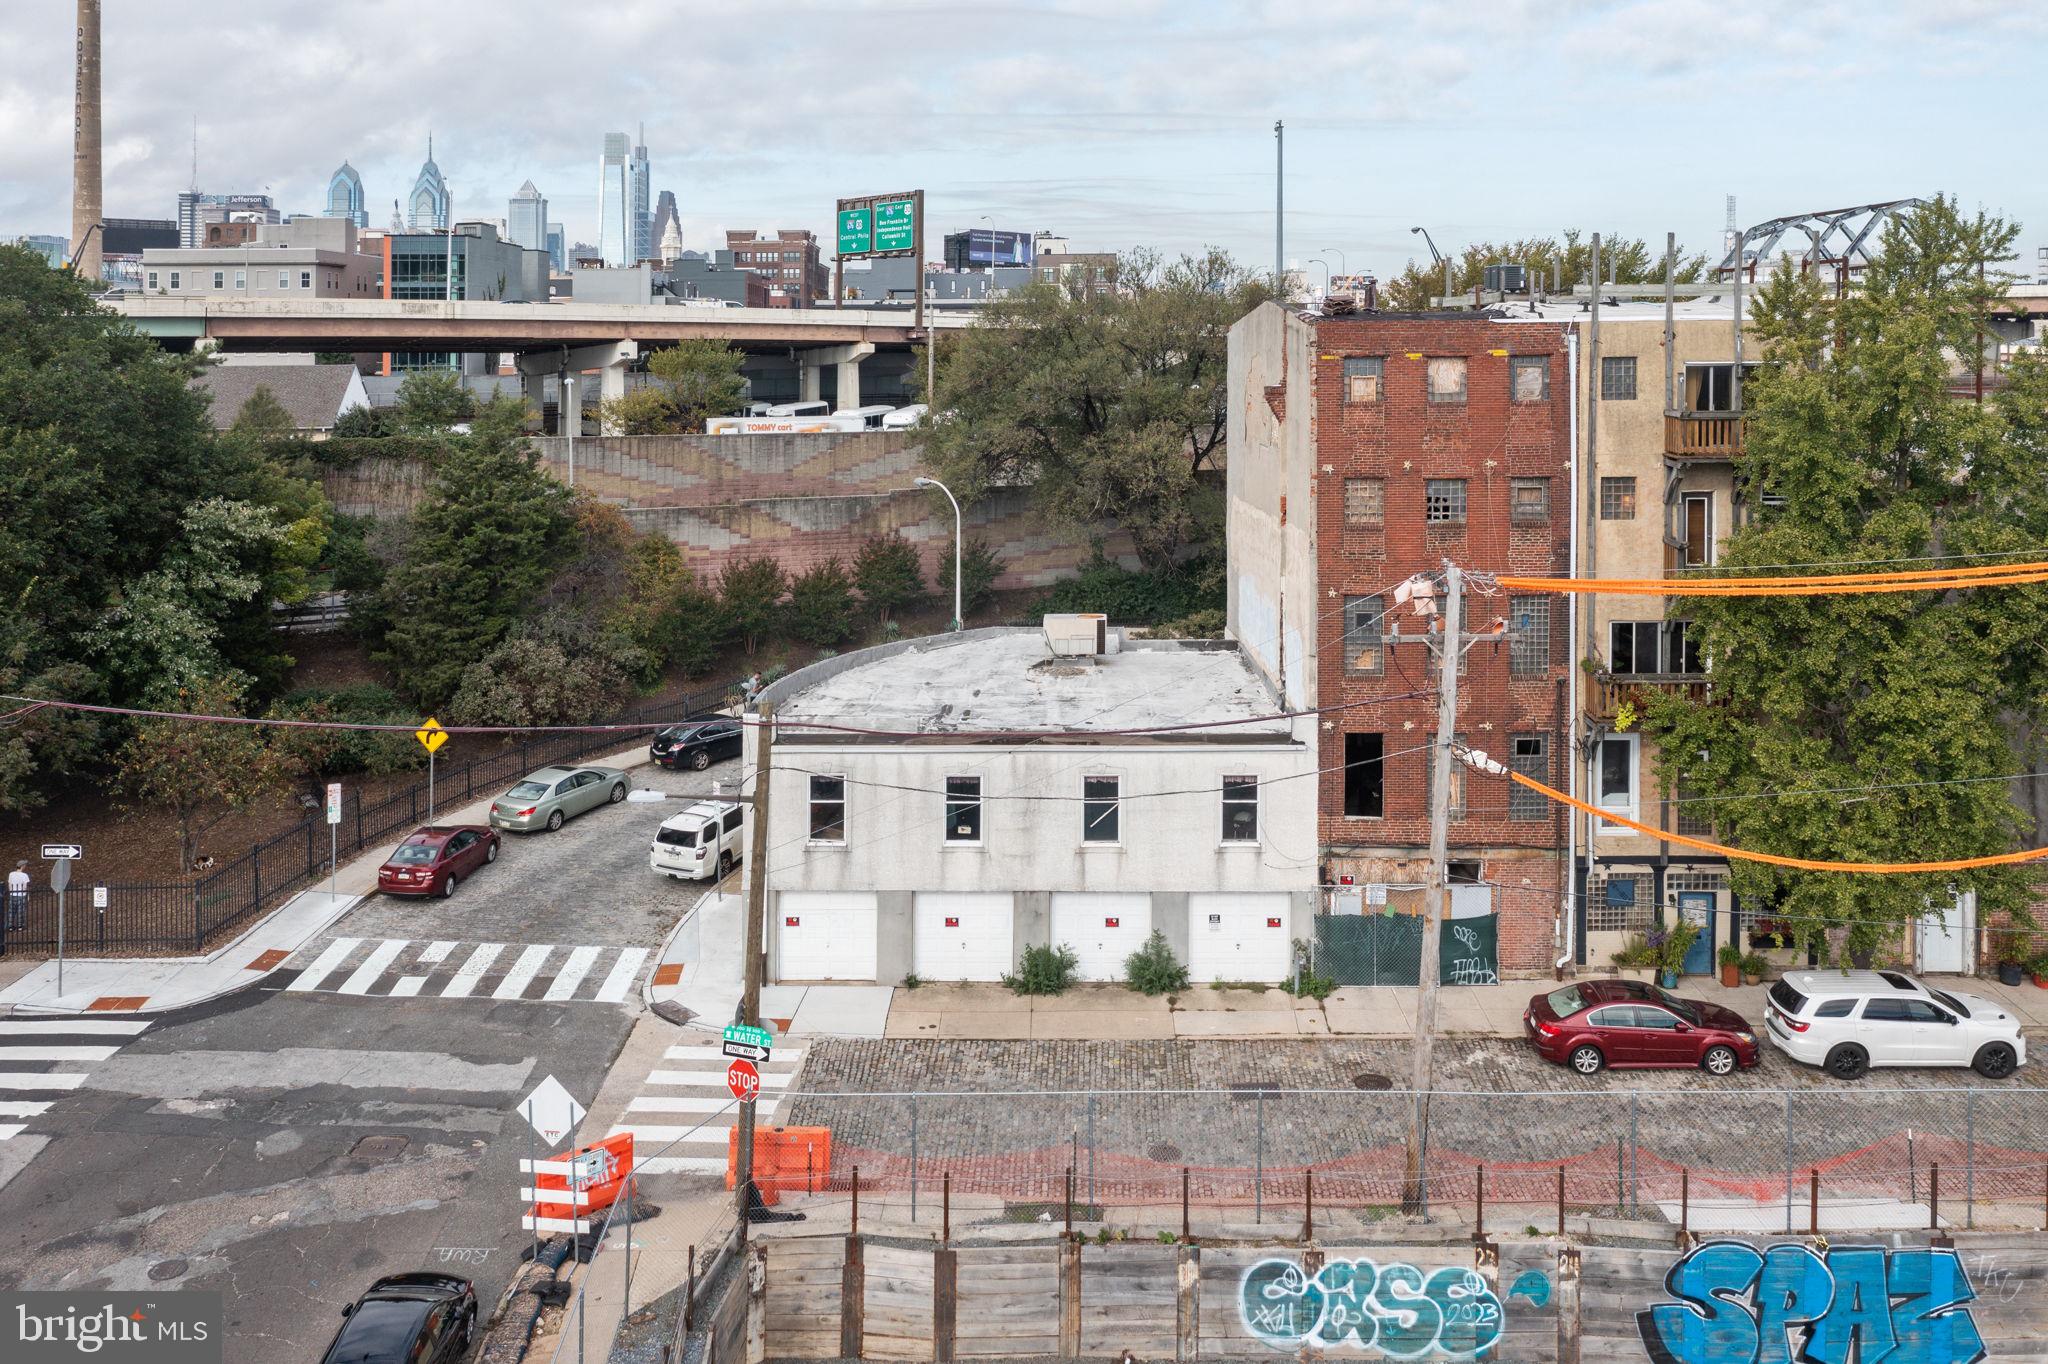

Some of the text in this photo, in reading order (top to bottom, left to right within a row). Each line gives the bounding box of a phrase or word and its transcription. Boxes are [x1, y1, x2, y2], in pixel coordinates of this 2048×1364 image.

[231, 195, 262, 203] Jefferson
[746, 424, 777, 432] TOMMY
[733, 1030, 762, 1045] WATER
[763, 1039, 772, 1047] ST
[727, 1045, 741, 1053] ONE
[729, 1069, 758, 1091] STOP
[1635, 1240, 1990, 1364] SPAZ
[1446, 1301, 1499, 1327] 2023
